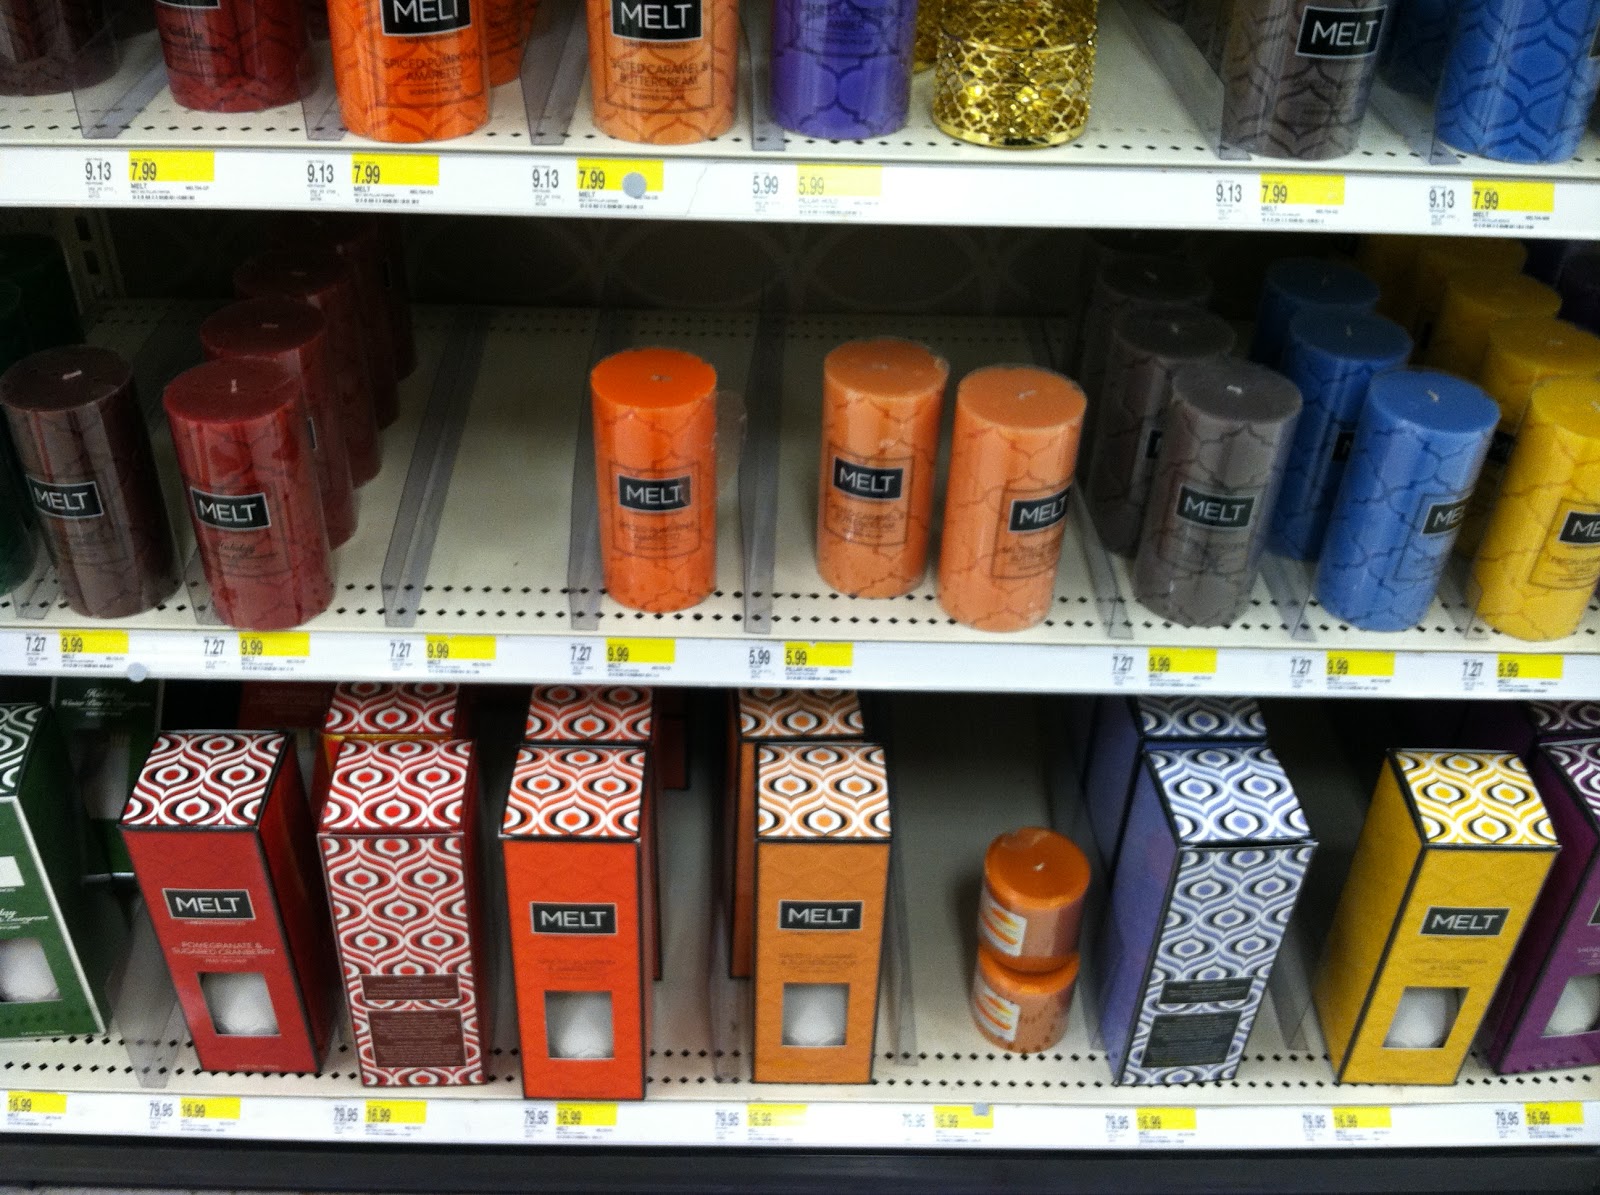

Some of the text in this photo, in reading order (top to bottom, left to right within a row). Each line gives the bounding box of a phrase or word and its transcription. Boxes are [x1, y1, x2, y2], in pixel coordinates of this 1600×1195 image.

[620, 1, 693, 29] MELT
[1311, 20, 1378, 46] MELT
[85, 161, 112, 181] 9.13
[130, 162, 157, 181] 7.99
[307, 163, 334, 183] 9.13
[353, 164, 381, 184] 7.99
[532, 168, 559, 189] 9.13
[578, 169, 606, 189] 7.99
[752, 175, 779, 195] 5.99
[798, 176, 825, 196] 5.99
[1215, 183, 1242, 203] 9.13
[1261, 184, 1288, 204] 7.99
[1429, 189, 1455, 209] 9.13
[1473, 190, 1499, 210] 7.99
[838, 466, 896, 493] MELT
[33, 486, 89, 511] MELT
[626, 484, 684, 504] MELT
[199, 498, 257, 523] MELT
[1018, 494, 1068, 525] MELT
[1184, 495, 1246, 522] MELT
[25, 636, 47, 652] 7.27
[61, 637, 84, 653] 9.99
[203, 639, 225, 655] 7.27
[241, 639, 263, 656] 9.99
[389, 642, 412, 658] 7.27
[426, 642, 449, 659] 9.99
[570, 645, 592, 661] 7.27
[607, 646, 630, 662] 9.99
[748, 649, 771, 665] 5.99
[785, 649, 808, 666] 5.99
[174, 896, 240, 914] MELT
[540, 910, 607, 927] MELT
[787, 907, 854, 924] MELT
[1431, 914, 1500, 930] MELT
[181, 941, 251, 950] POMEGRANATE
[149, 1102, 174, 1118] 79.95
